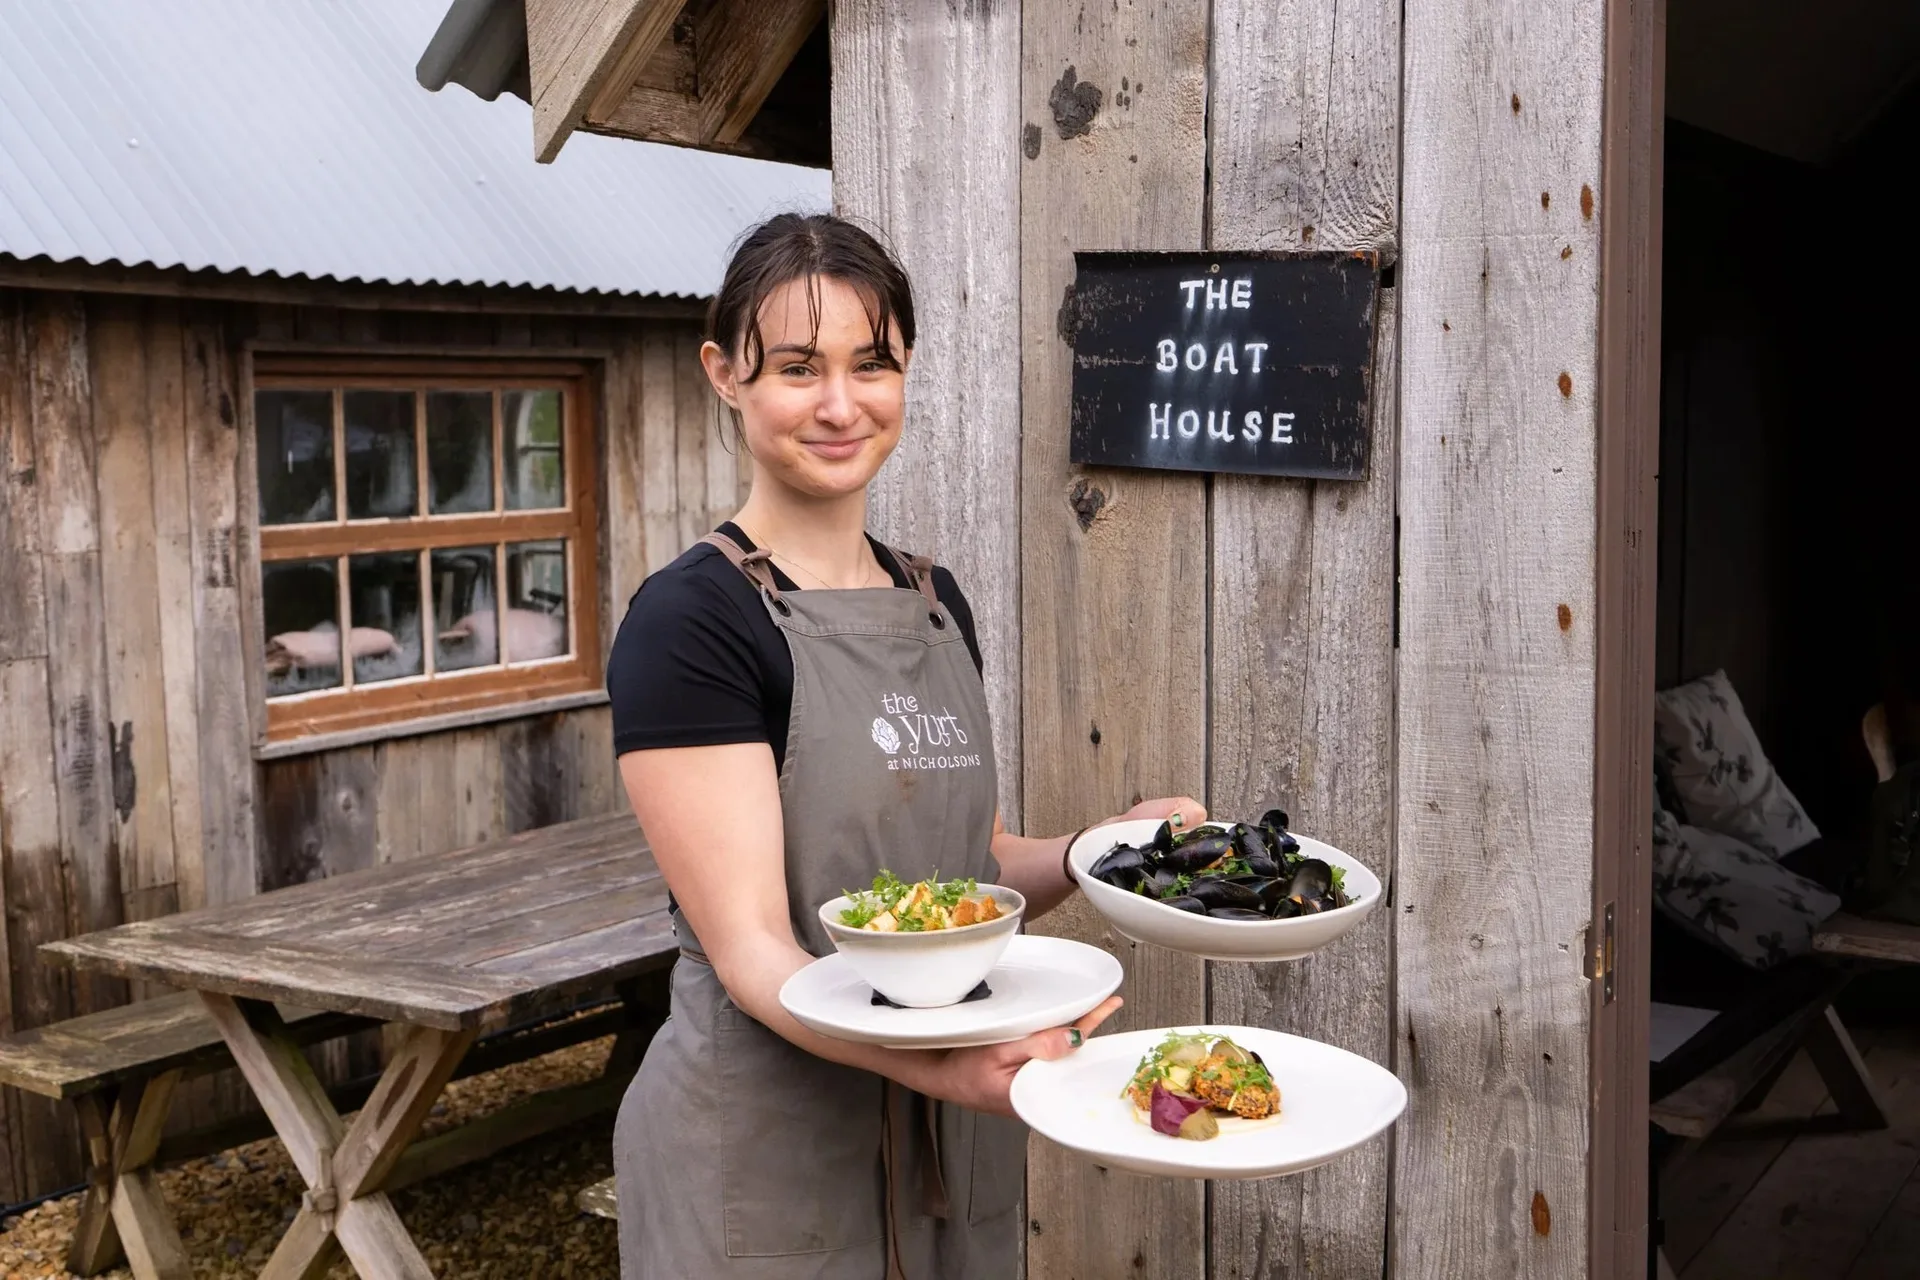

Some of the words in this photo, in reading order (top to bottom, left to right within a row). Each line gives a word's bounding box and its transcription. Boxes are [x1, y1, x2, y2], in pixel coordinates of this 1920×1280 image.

[1180, 278, 1252, 310] THE
[1156, 339, 1268, 374] BOAT
[1150, 402, 1295, 444] HOUSE
[881, 693, 918, 714] the
[898, 707, 968, 754] yurt
[887, 759, 900, 770] at
[902, 754, 981, 770] NICHOLSONS
